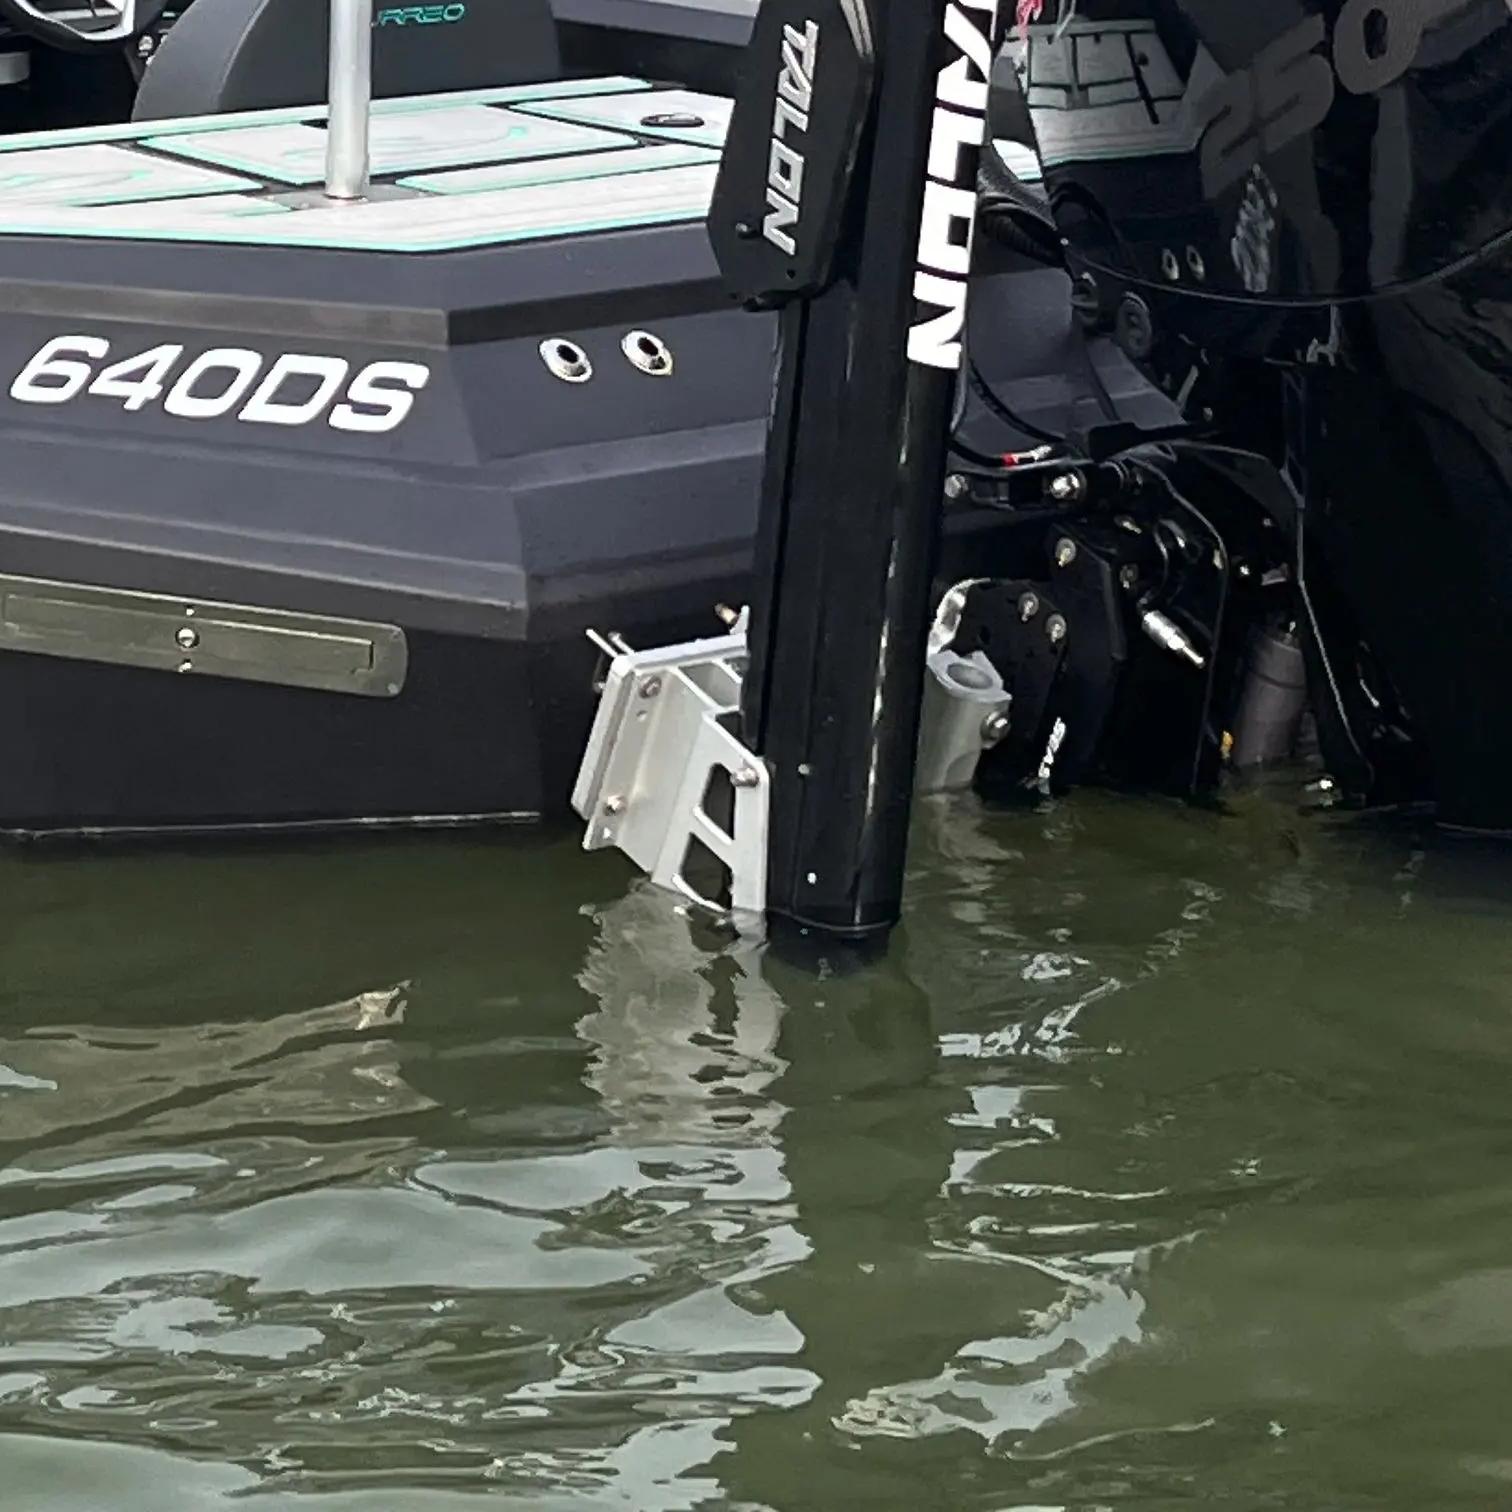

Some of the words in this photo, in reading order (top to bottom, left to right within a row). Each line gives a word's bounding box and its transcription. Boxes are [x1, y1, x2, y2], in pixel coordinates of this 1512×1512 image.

[370, 2, 466, 27] RREO
[761, 18, 819, 256] TALON
[9, 334, 431, 434] 640DS
